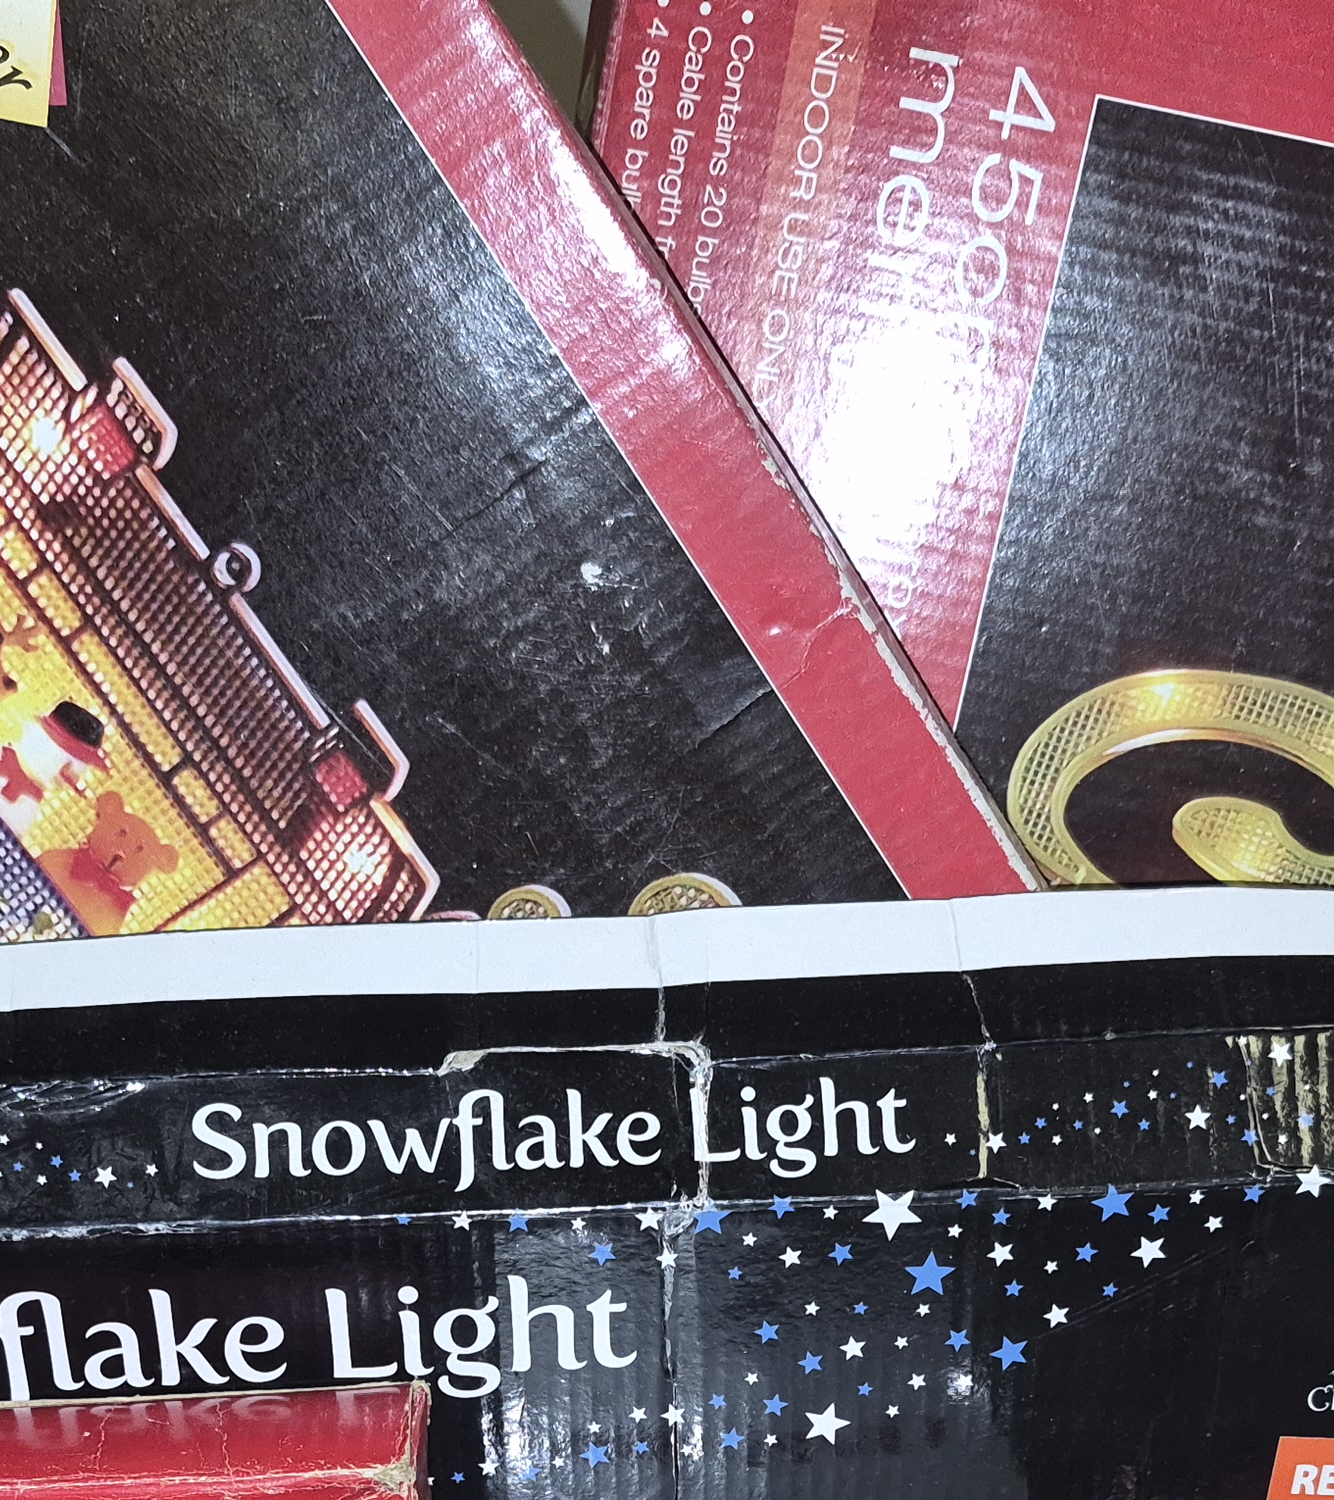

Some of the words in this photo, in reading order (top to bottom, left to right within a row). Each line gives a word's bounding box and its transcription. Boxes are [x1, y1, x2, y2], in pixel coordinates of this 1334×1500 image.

[647, 17, 669, 37] 4
[676, 27, 711, 120] Cable
[631, 48, 660, 139] spare
[710, 34, 754, 176] Contains
[789, 24, 847, 200] INDOOR
[658, 128, 695, 227] length
[700, 185, 726, 228] 20
[776, 213, 809, 299] USE
[191, 1088, 661, 1192] Snowflake
[692, 1077, 916, 1178] Light
[323, 1274, 637, 1397] Light
